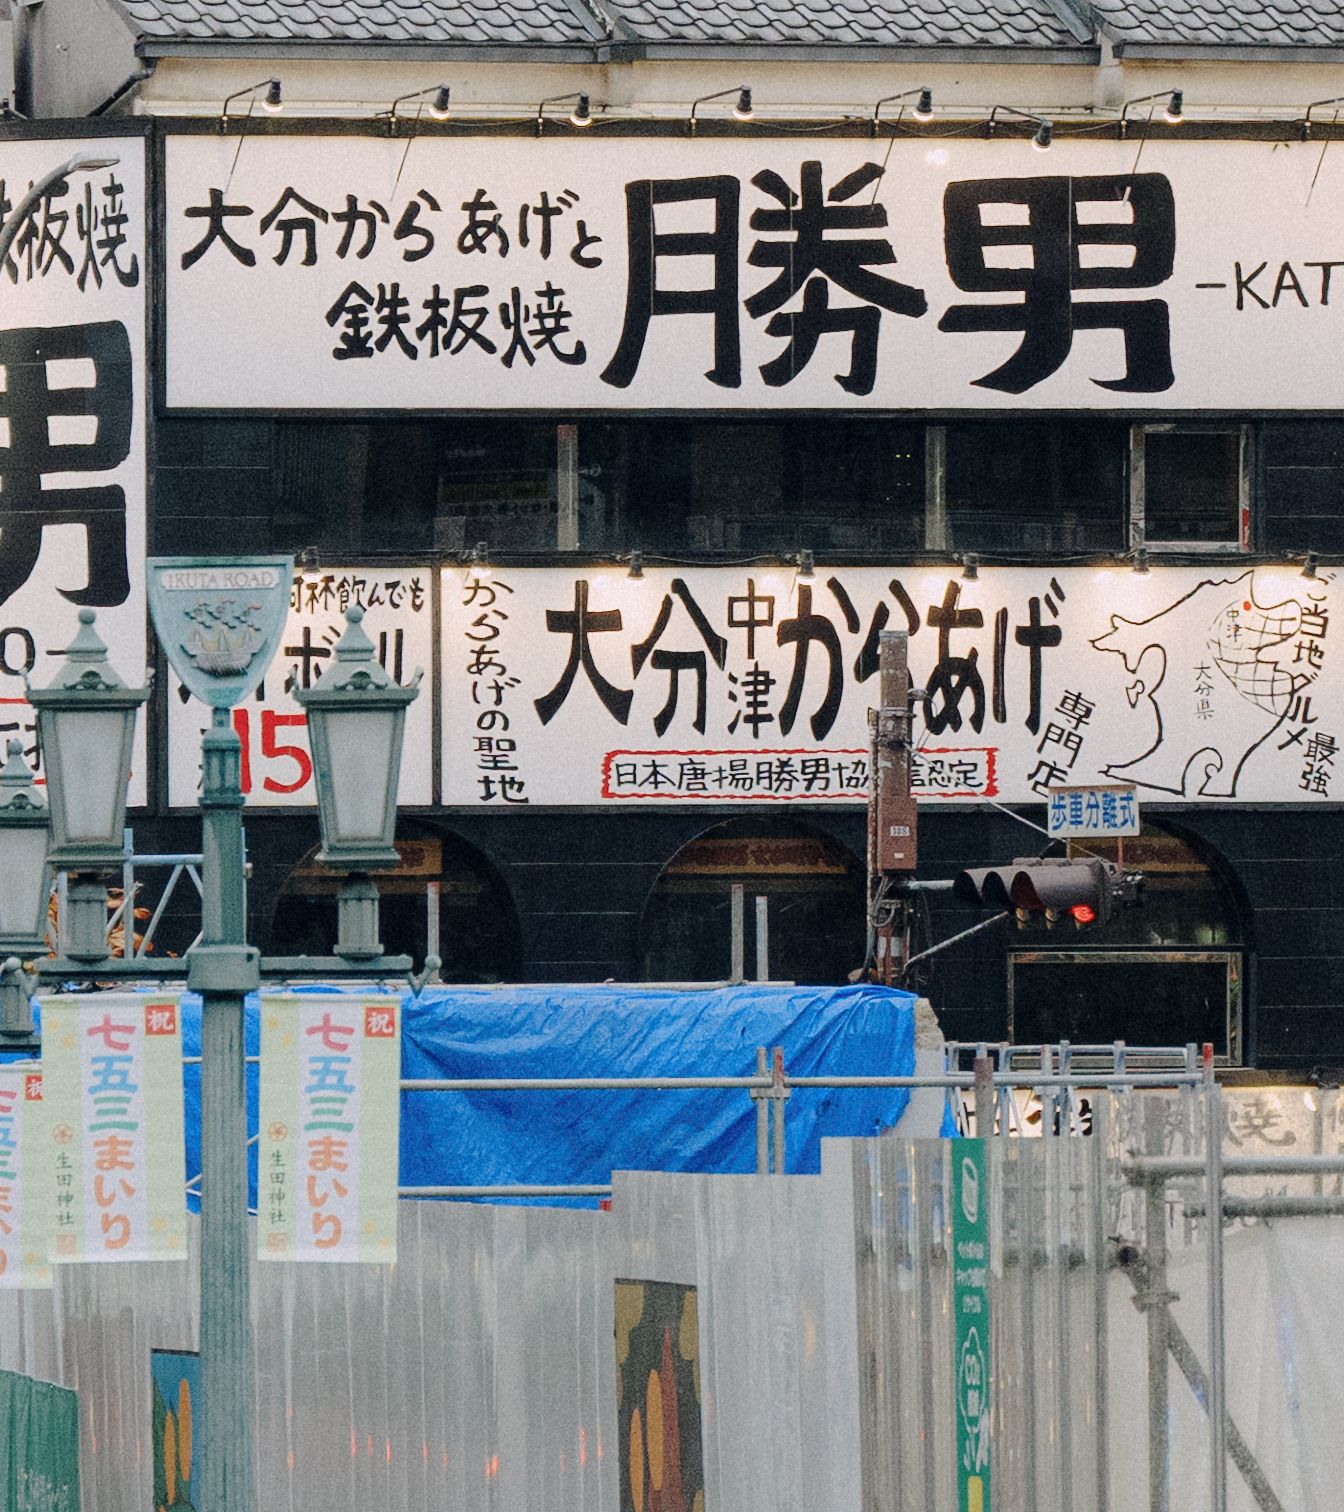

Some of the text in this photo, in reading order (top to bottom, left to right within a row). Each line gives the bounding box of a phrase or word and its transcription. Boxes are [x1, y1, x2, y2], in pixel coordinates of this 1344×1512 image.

[180, 185, 604, 271] 大分からあげと
[600, 159, 1178, 397] 勝男
[325, 279, 588, 370] 鉄板焼
[168, 572, 275, 588] IKUTA ROAD
[461, 578, 530, 804] からあげの聖地
[1193, 661, 1215, 720] 大分県
[615, 757, 984, 792] 日本唐揚勝男協認定
[1026, 688, 1097, 798] 専門店
[1300, 732, 1340, 798] 最強
[1051, 791, 1136, 831] 歩車分離式
[148, 1006, 175, 1034] 祝
[367, 1009, 394, 1035] 祝
[87, 1013, 139, 1250] 七五三まいり
[304, 1013, 355, 1249] 七五三まいり
[56, 1150, 75, 1227] 生田神社
[268, 1148, 287, 1225] 生田神社
